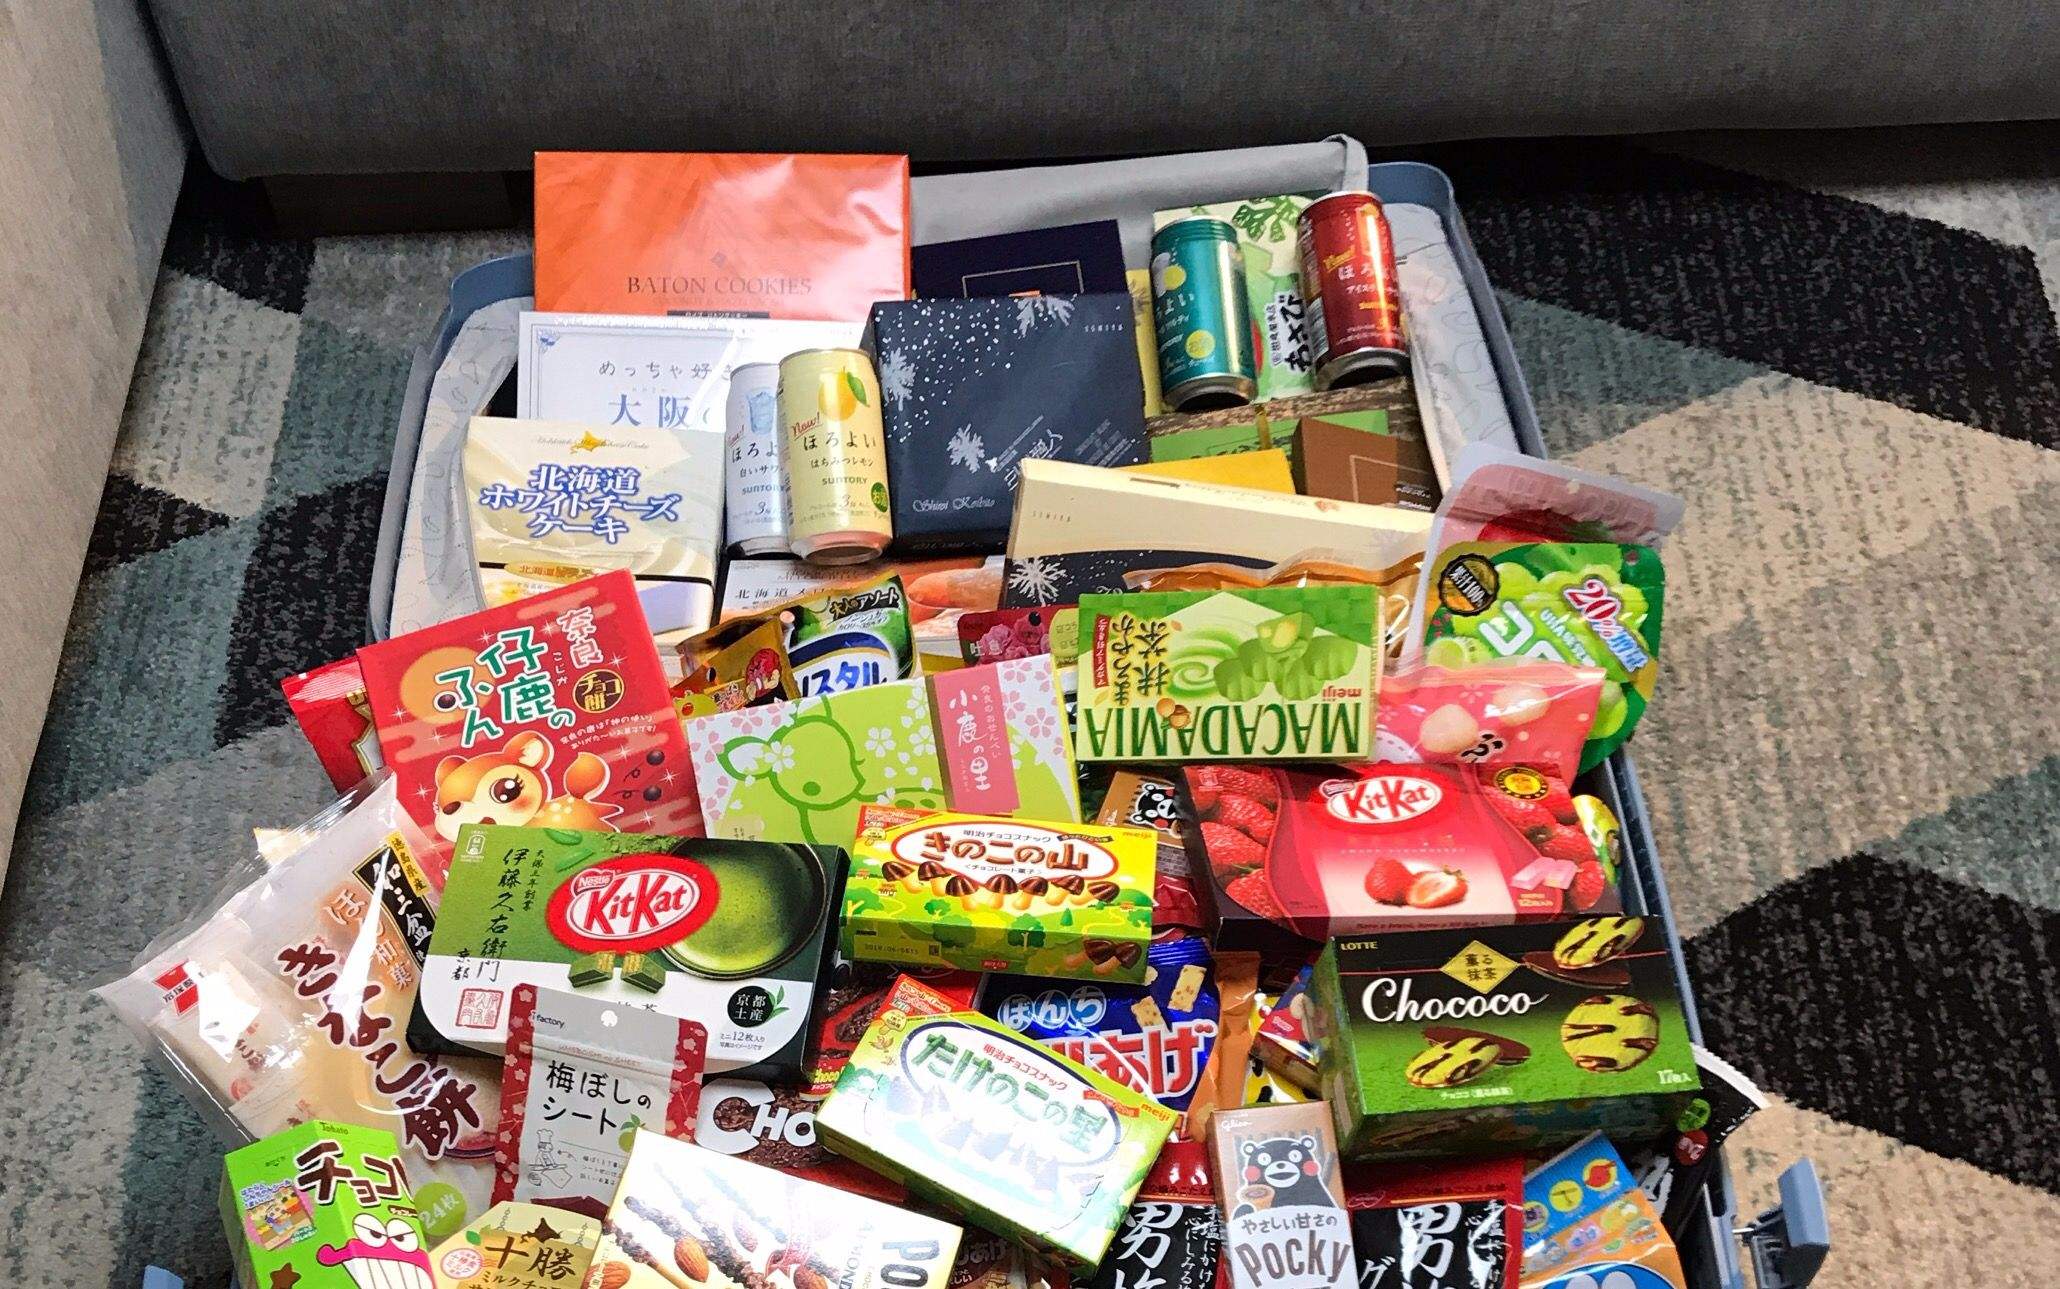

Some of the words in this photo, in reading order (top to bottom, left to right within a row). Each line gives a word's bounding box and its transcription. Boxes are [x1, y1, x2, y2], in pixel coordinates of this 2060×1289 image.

[628, 276, 707, 296] BATON
[714, 276, 812, 297] COOKIES
[610, 393, 692, 428] 大阪
[803, 431, 877, 451] ほろよい
[526, 463, 642, 496] 北海道
[479, 484, 684, 525] ホワイトチーズ
[526, 511, 630, 545] ケーキ
[557, 606, 603, 669] 奈良
[1133, 620, 1170, 697] 抹茶
[578, 673, 623, 697] チョコ
[1322, 686, 1362, 701] meiji
[1083, 702, 1361, 758] MACADAMIA
[1342, 779, 1431, 820] KitKat
[920, 831, 1090, 871] きのこの山
[963, 829, 1051, 843] 明治チョコスナック
[476, 848, 530, 983] 伊藤久右衛門
[583, 868, 688, 936] KitKat
[1340, 941, 1379, 951] LOTTE
[733, 1006, 764, 1022] 土産
[735, 993, 767, 1008] 京都
[1361, 976, 1550, 1023] Chococo
[546, 1060, 651, 1110] 梅ぼしの
[983, 1043, 1068, 1091] 明治チョコスナック
[910, 1034, 1108, 1154] たけのこの里
[1141, 1102, 1171, 1122] meiji
[543, 1096, 618, 1136] シート
[418, 1193, 460, 1230] 24枚
[1241, 1212, 1338, 1236] やさしい甘さの
[485, 1235, 577, 1281] 十勝
